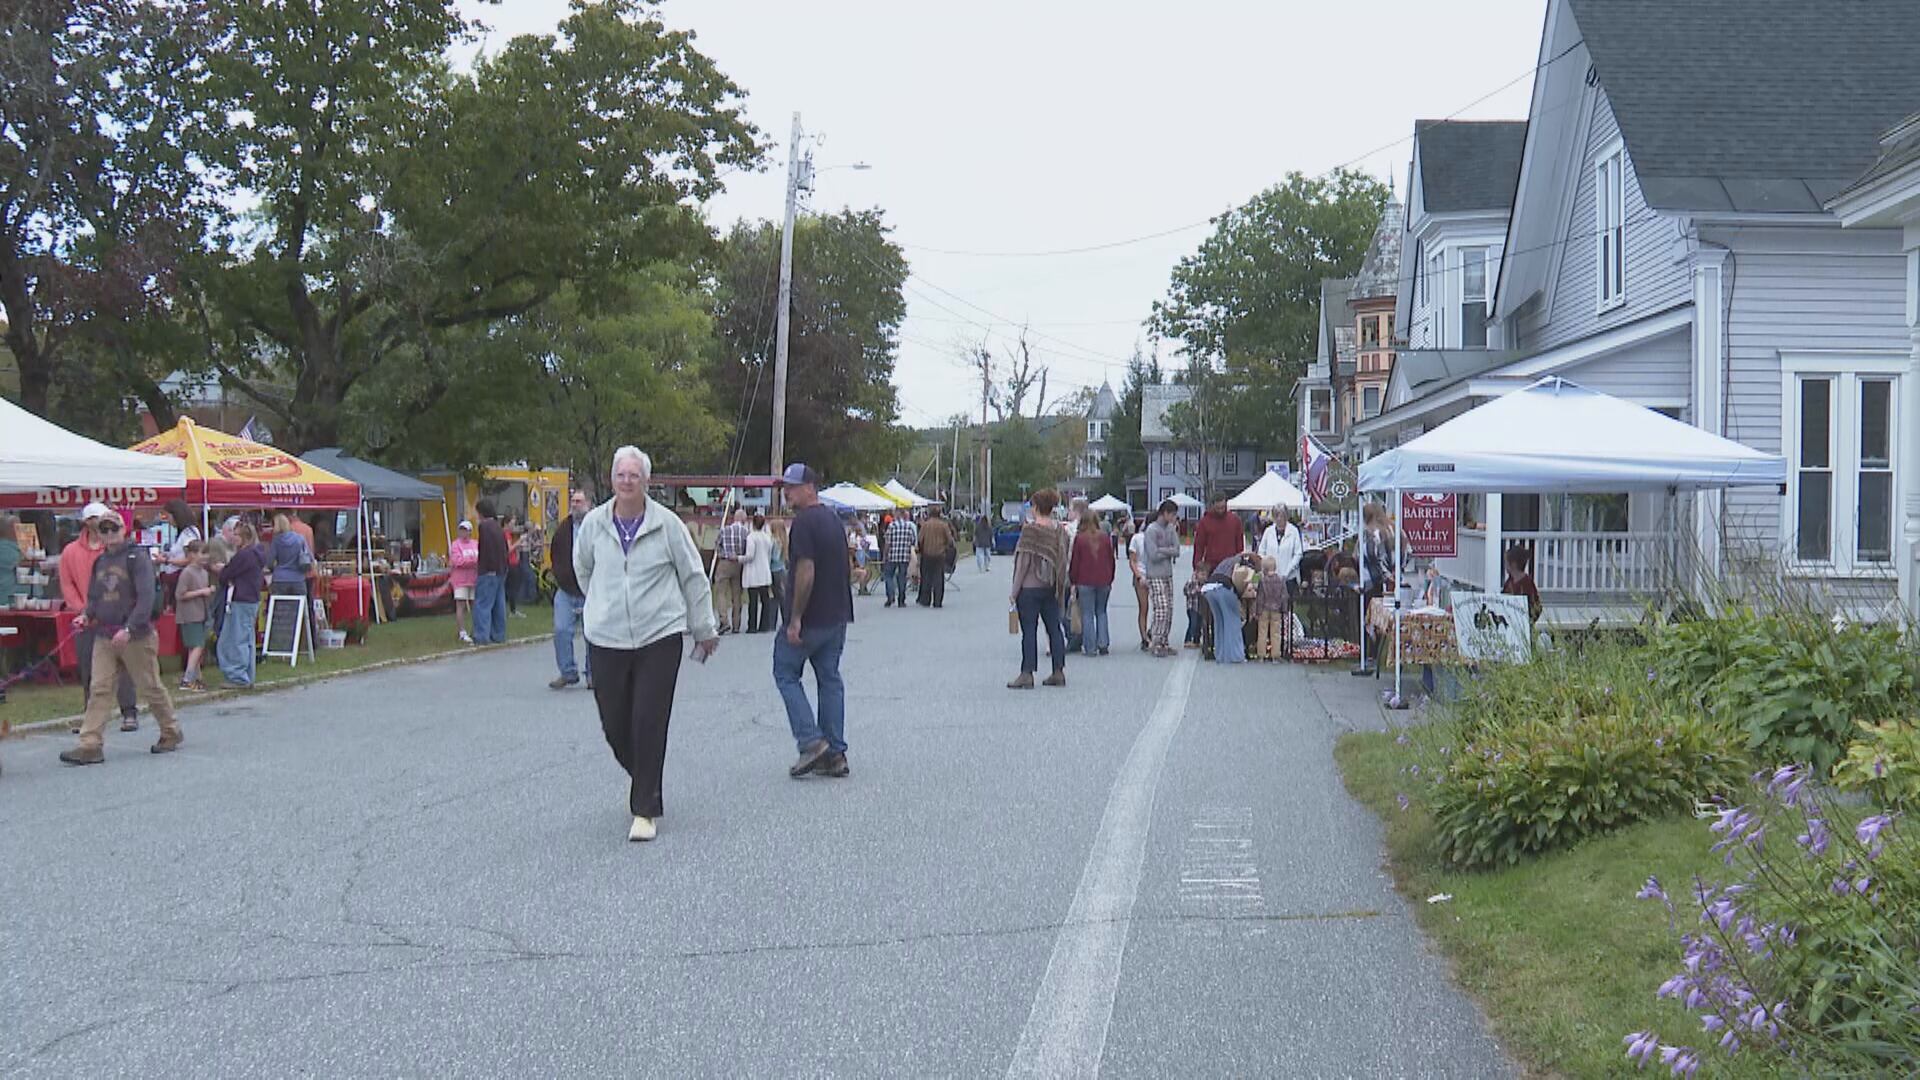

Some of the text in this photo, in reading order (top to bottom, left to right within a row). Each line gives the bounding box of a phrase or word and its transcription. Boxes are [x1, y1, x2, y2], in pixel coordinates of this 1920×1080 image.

[262, 482, 315, 495] SAUSAGES
[1404, 508, 1453, 518] BARRETT
[1424, 520, 1433, 530] &
[1408, 531, 1448, 541] VALLEY
